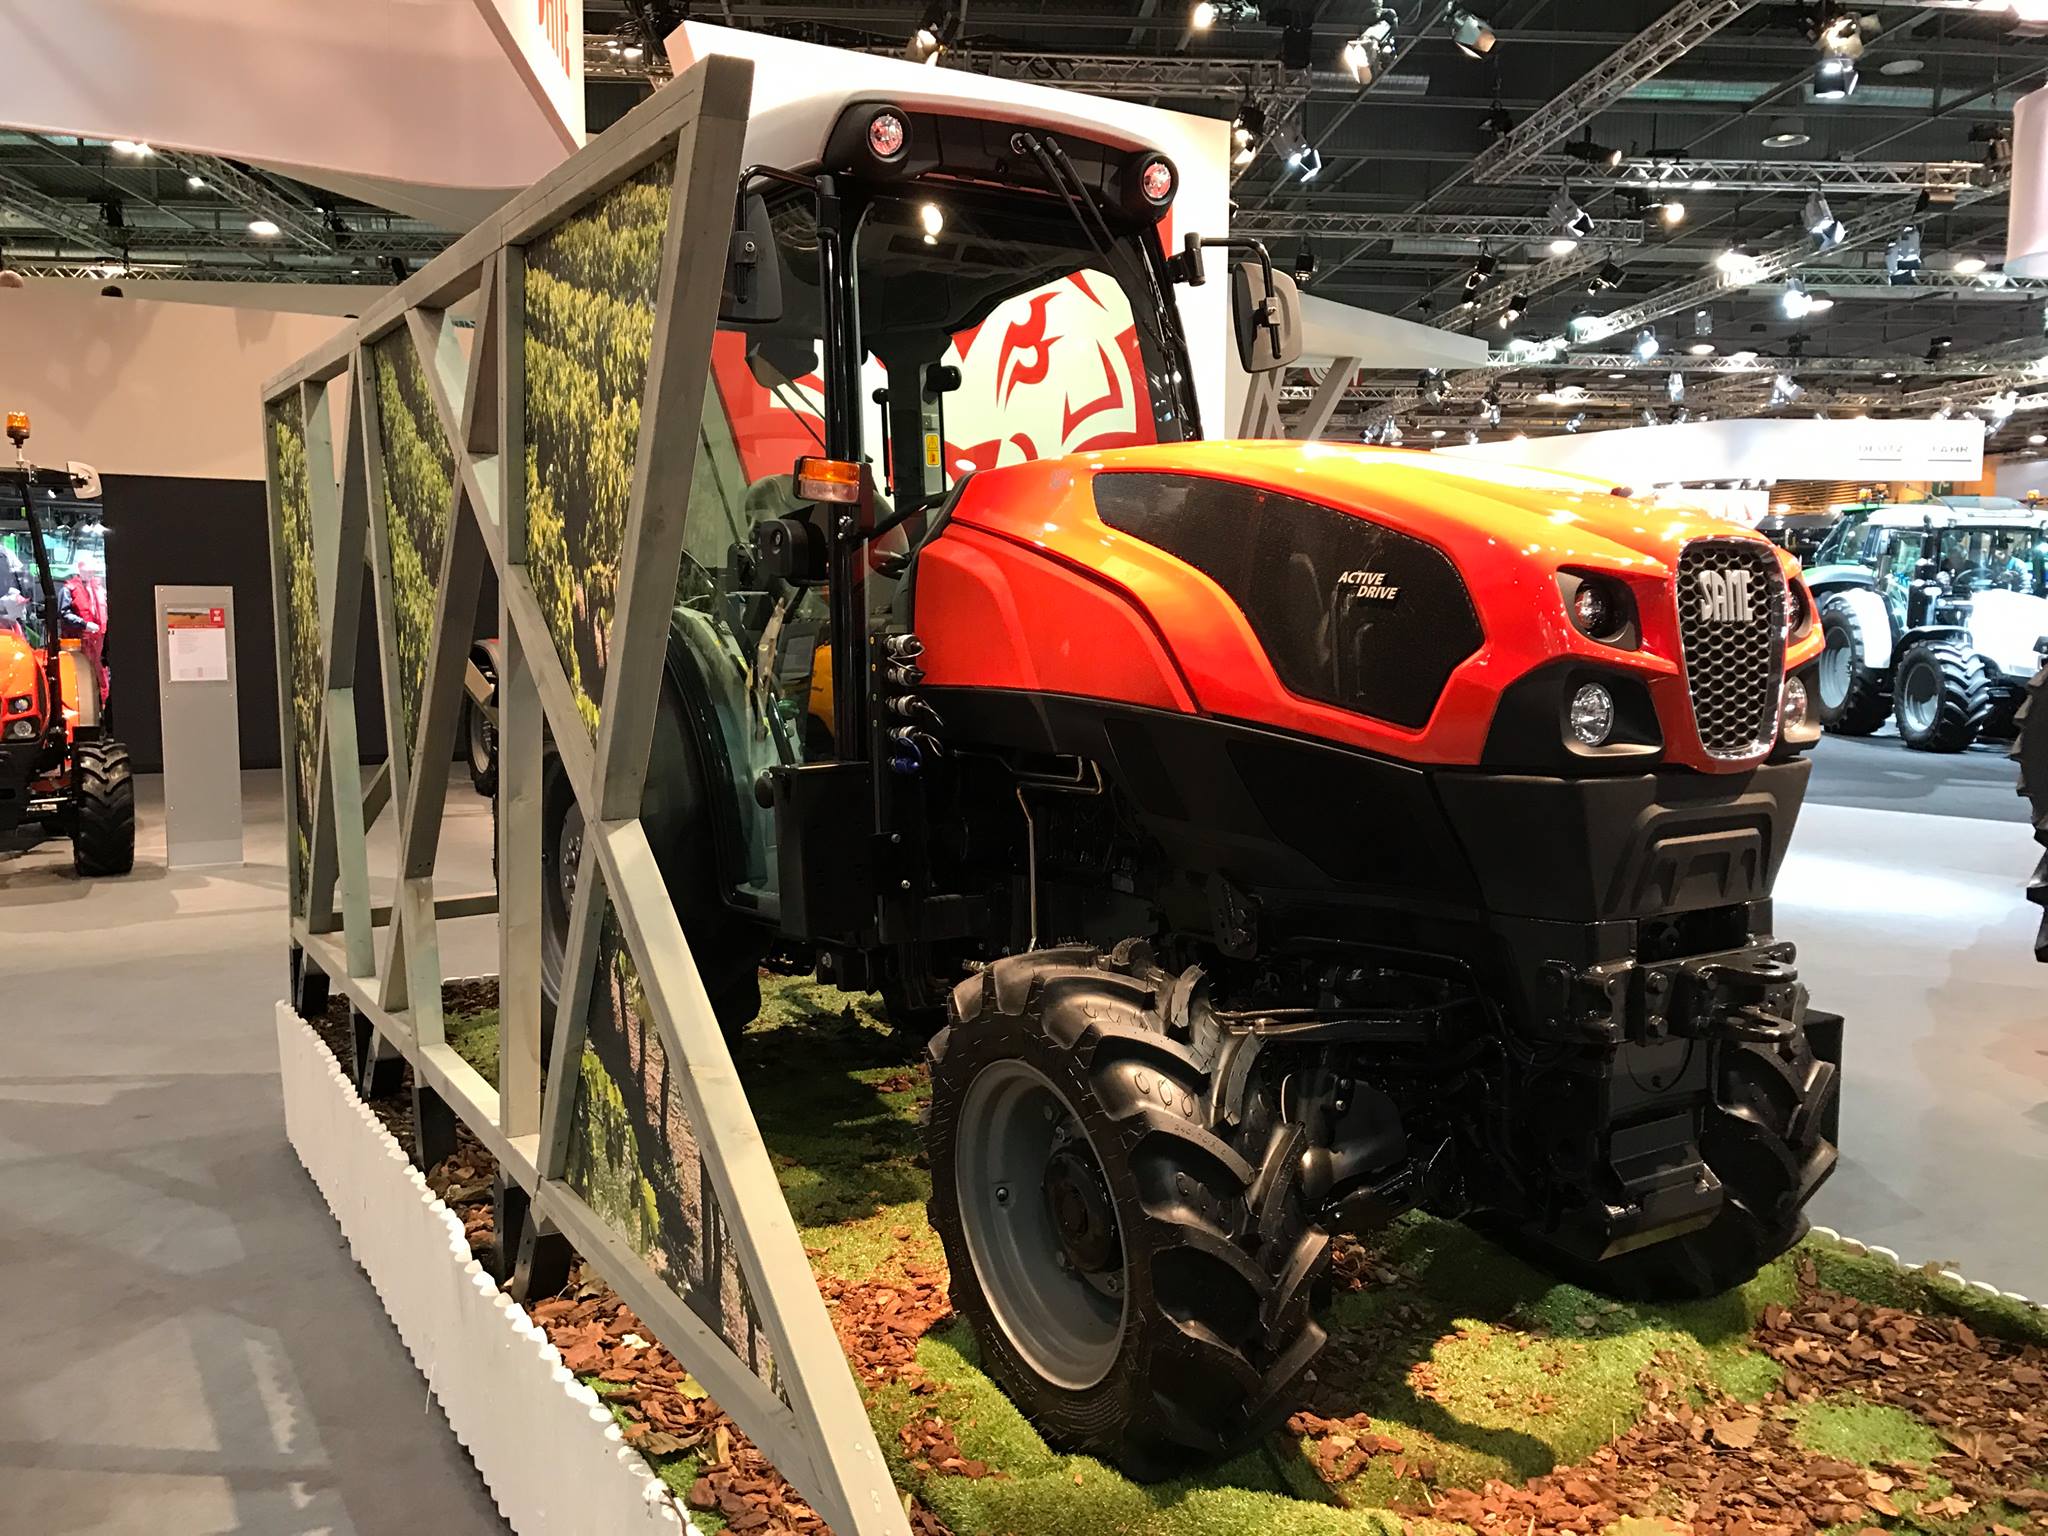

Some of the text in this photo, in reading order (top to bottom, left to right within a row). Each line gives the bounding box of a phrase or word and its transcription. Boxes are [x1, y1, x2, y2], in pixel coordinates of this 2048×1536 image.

[1338, 571, 1386, 585] ACTIVE
[1356, 585, 1399, 600] DRIVE
[1698, 569, 1754, 622] SAME
